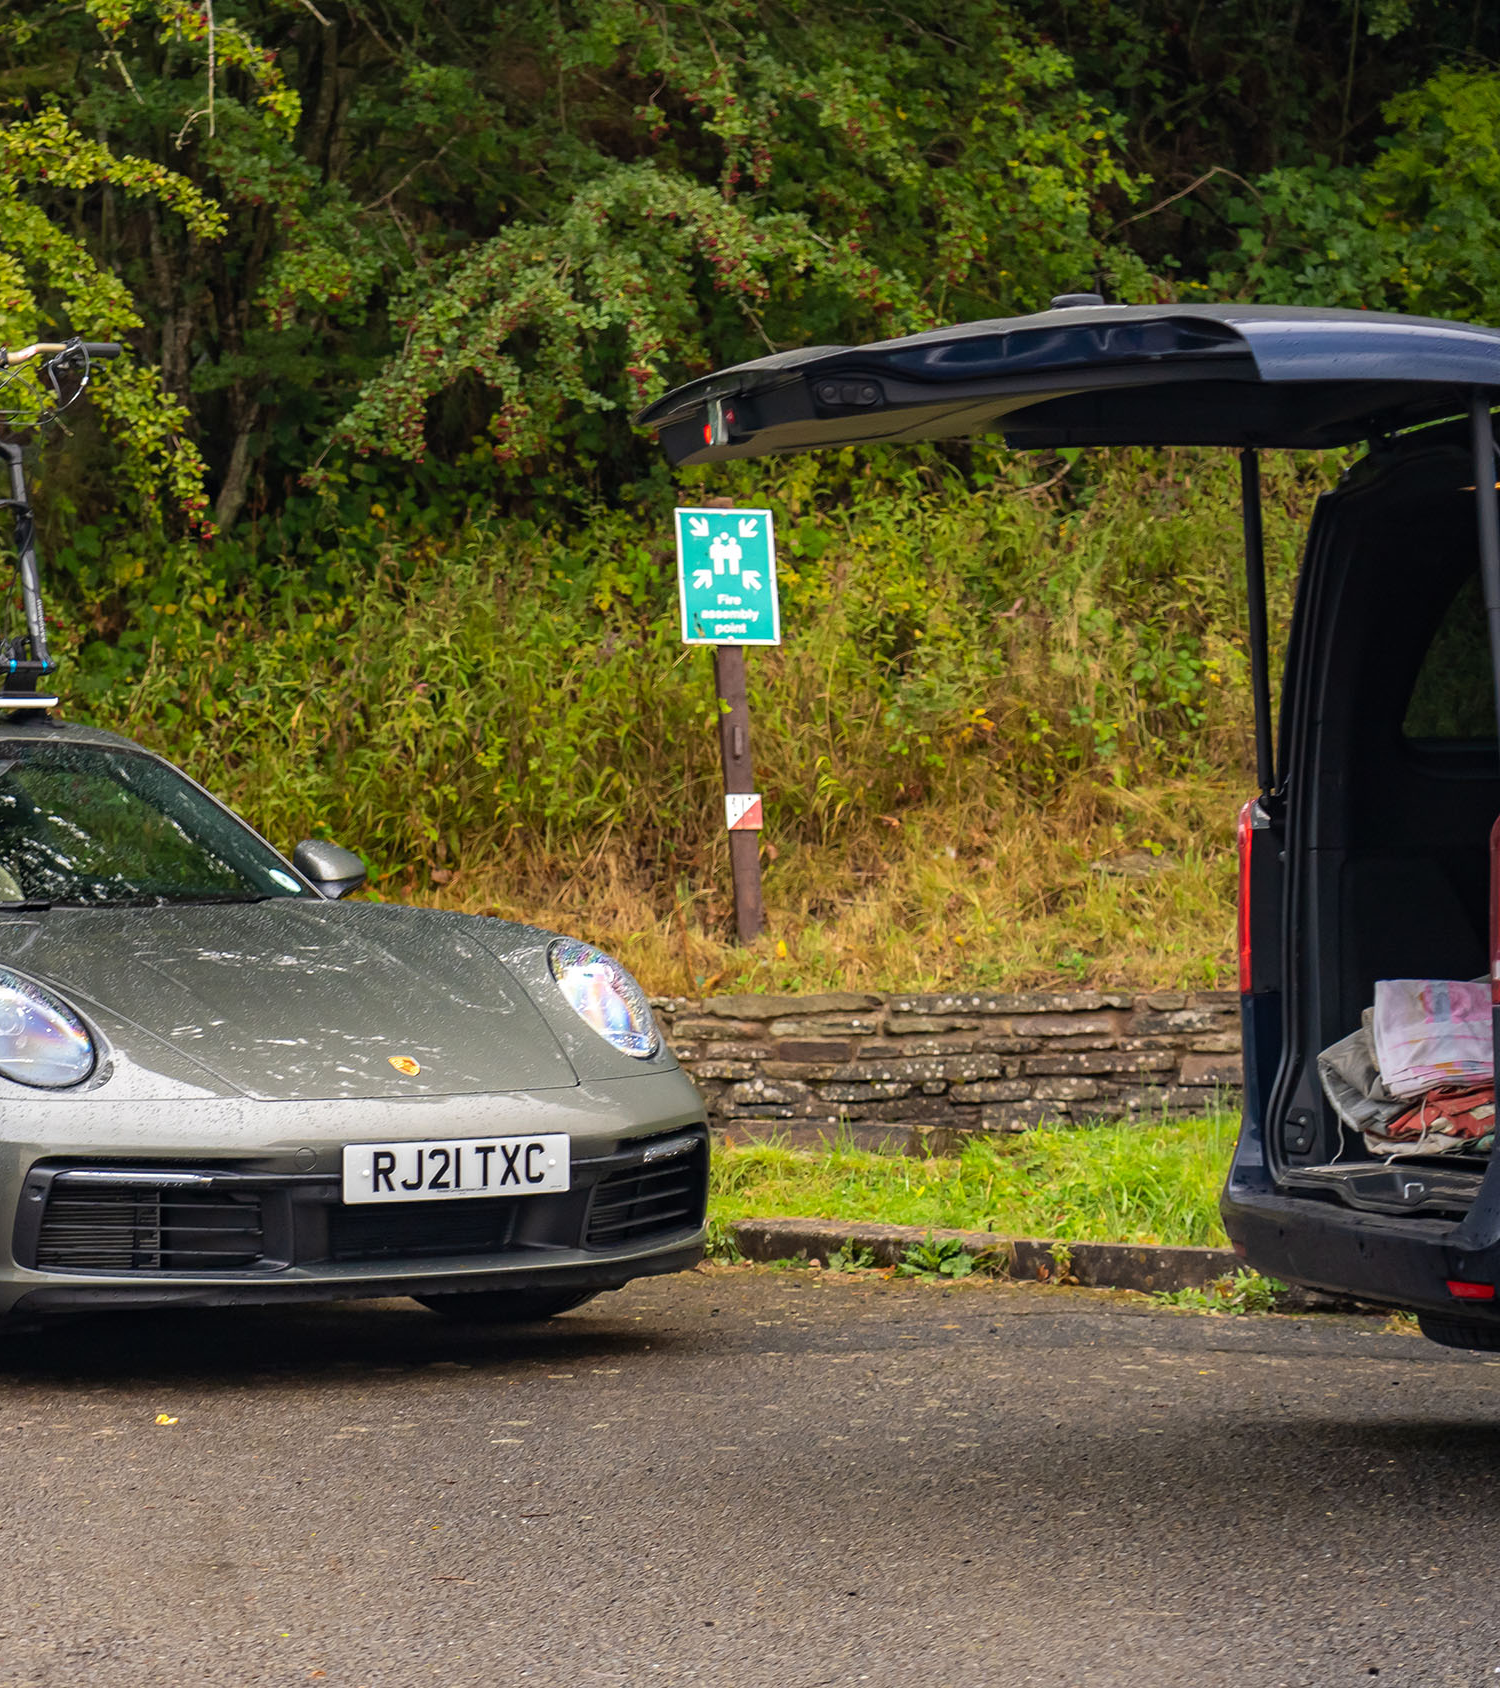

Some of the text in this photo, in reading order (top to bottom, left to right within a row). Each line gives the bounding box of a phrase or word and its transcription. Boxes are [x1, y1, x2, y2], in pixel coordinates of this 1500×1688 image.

[717, 594, 742, 605] Fire
[701, 608, 759, 622] assembly
[715, 622, 747, 635] point
[372, 1142, 546, 1193] RJ21 TXC
